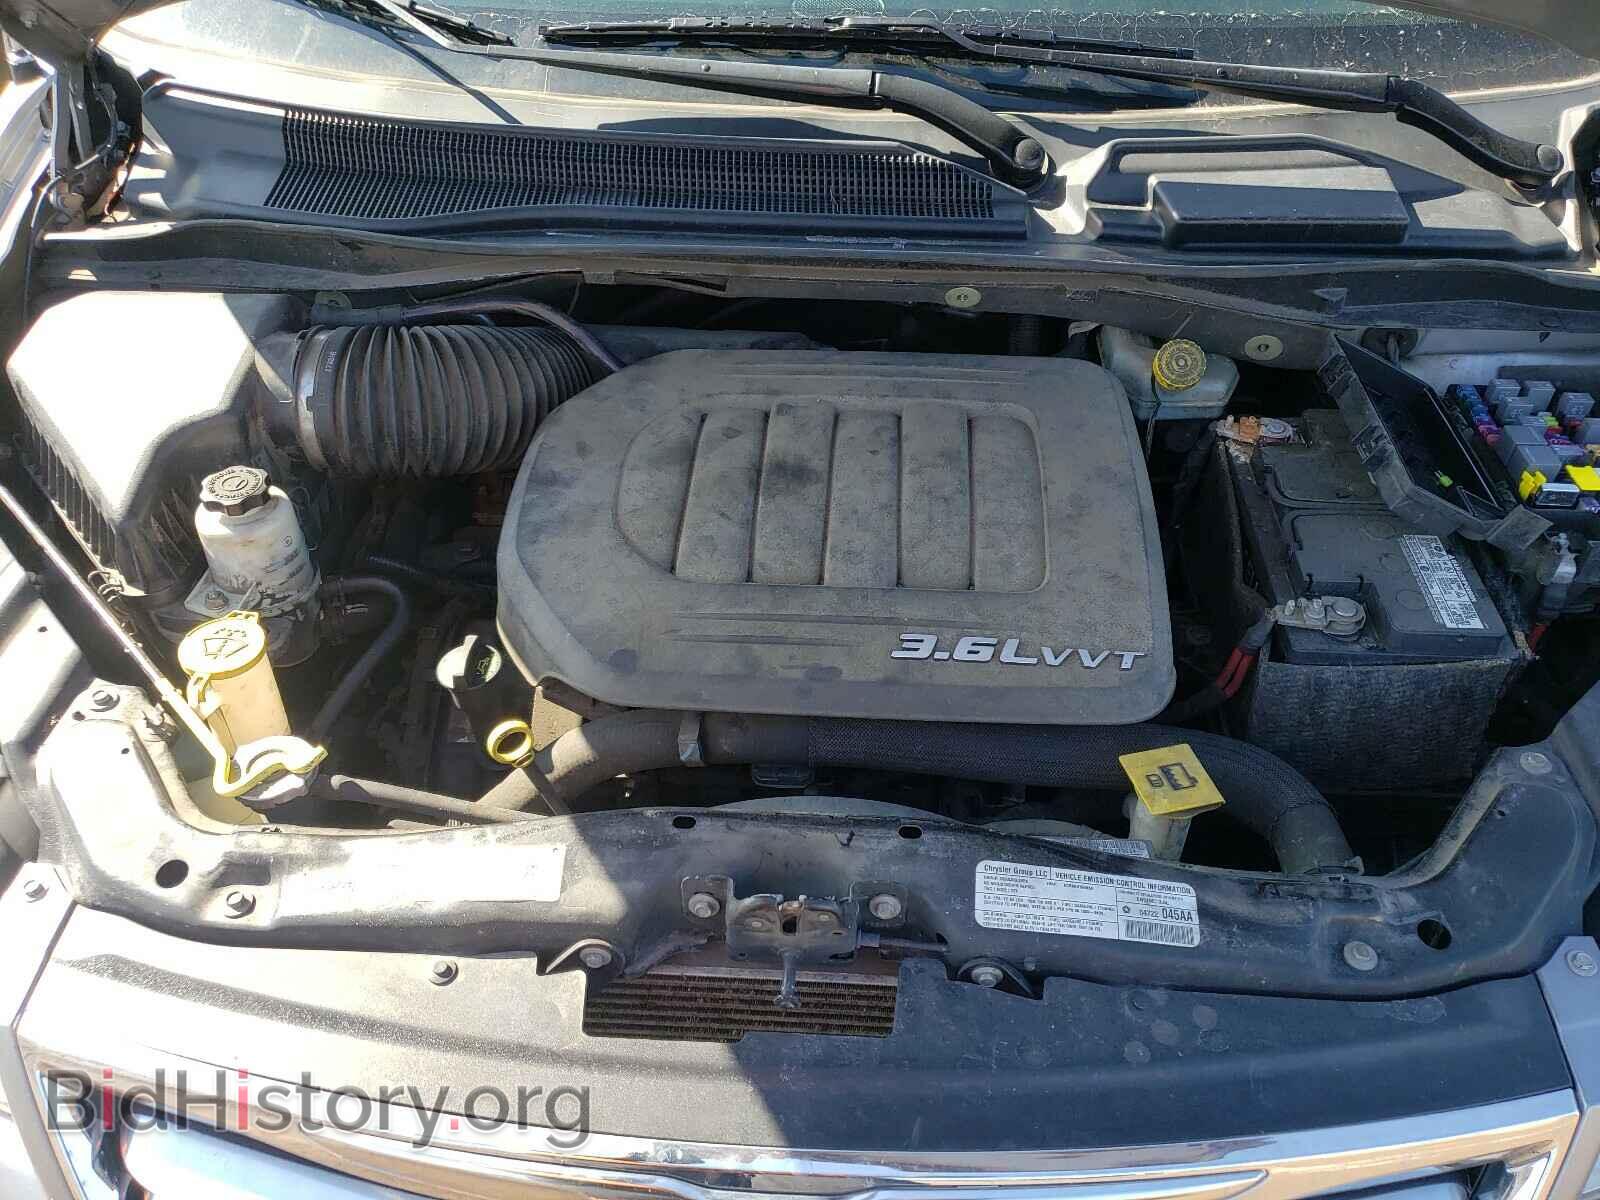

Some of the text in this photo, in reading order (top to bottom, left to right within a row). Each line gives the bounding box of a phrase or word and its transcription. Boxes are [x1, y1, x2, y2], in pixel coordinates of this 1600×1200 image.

[984, 863, 1048, 878] Chrysler Group LLC
[1055, 871, 1191, 895] VEHICLE EMISSION CONTROL INFORMATION
[1161, 907, 1193, 922] 045AA
